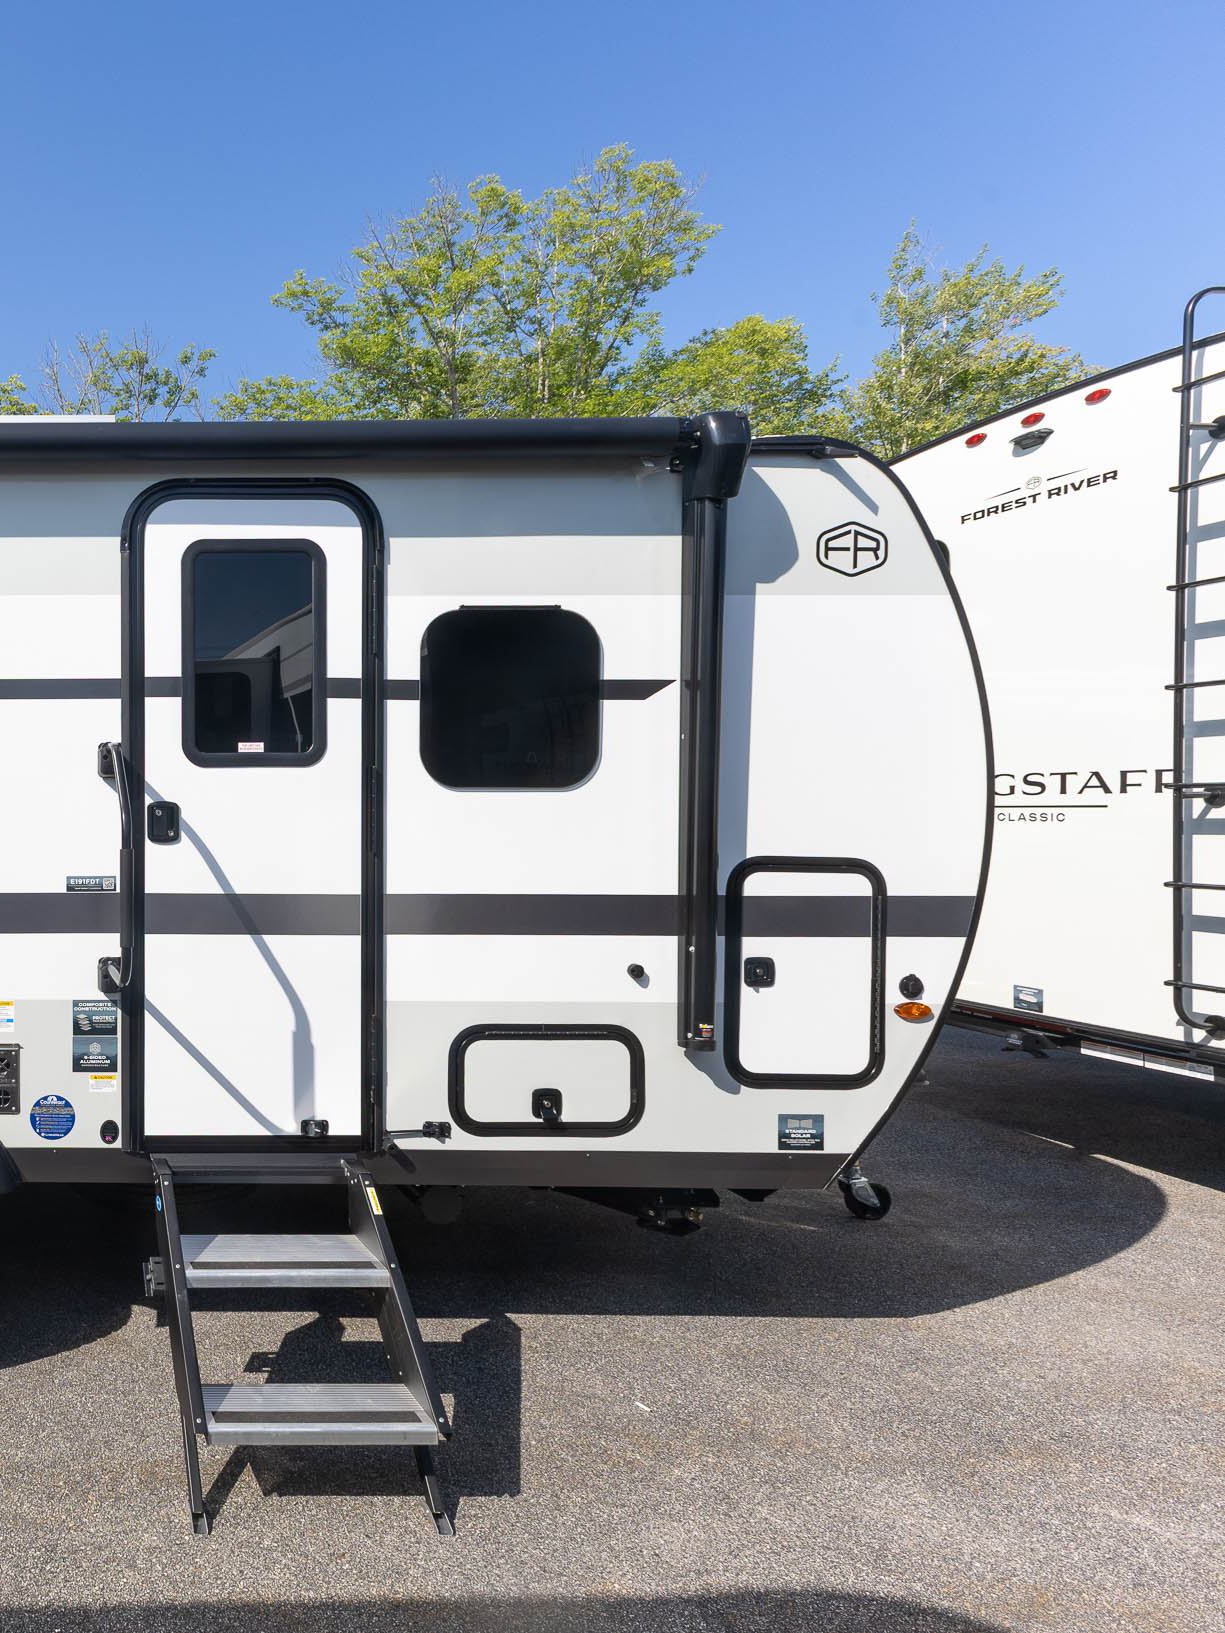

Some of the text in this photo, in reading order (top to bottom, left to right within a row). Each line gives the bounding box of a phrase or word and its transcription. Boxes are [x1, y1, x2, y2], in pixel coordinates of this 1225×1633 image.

[960, 493, 1042, 525] FOREST
[1047, 469, 1119, 499] RIVER
[997, 812, 1066, 823] CLASSIC
